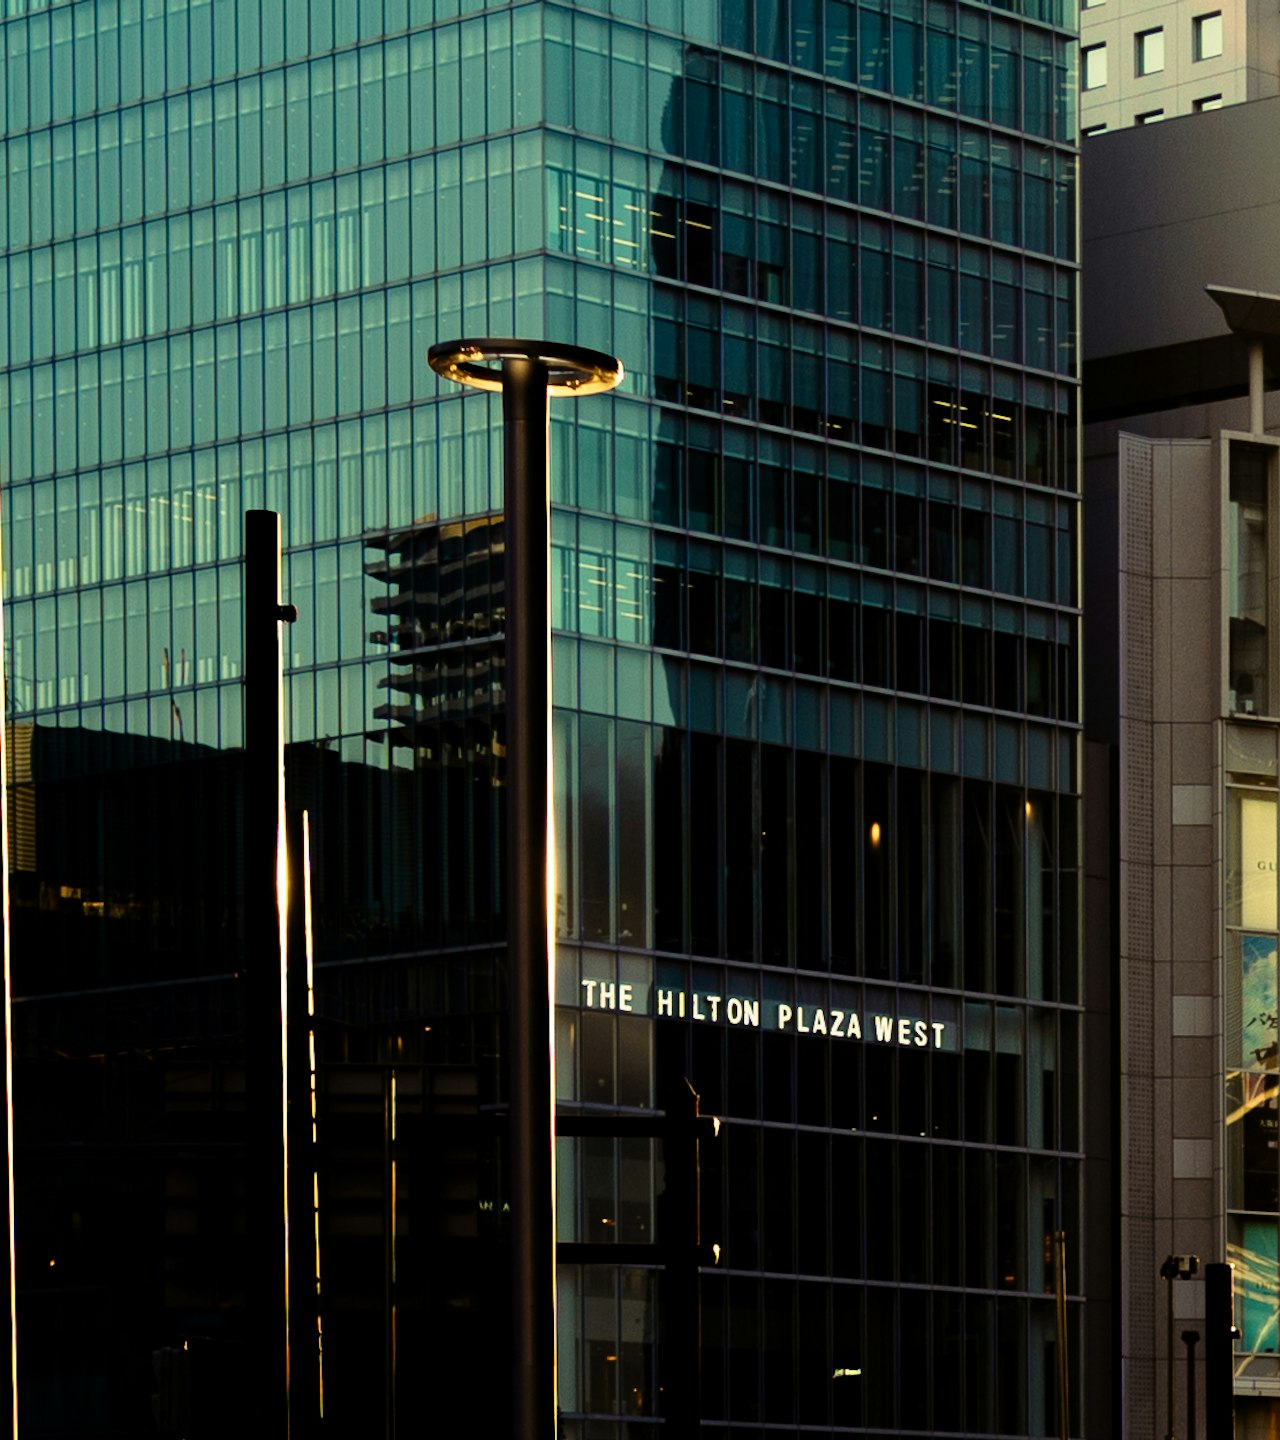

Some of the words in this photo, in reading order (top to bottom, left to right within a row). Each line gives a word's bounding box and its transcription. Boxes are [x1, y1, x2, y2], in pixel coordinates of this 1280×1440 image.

[581, 979, 633, 1012] THE
[658, 989, 760, 1027] HILTON
[778, 1004, 862, 1040] PLAZA
[875, 1015, 945, 1049] WEST
